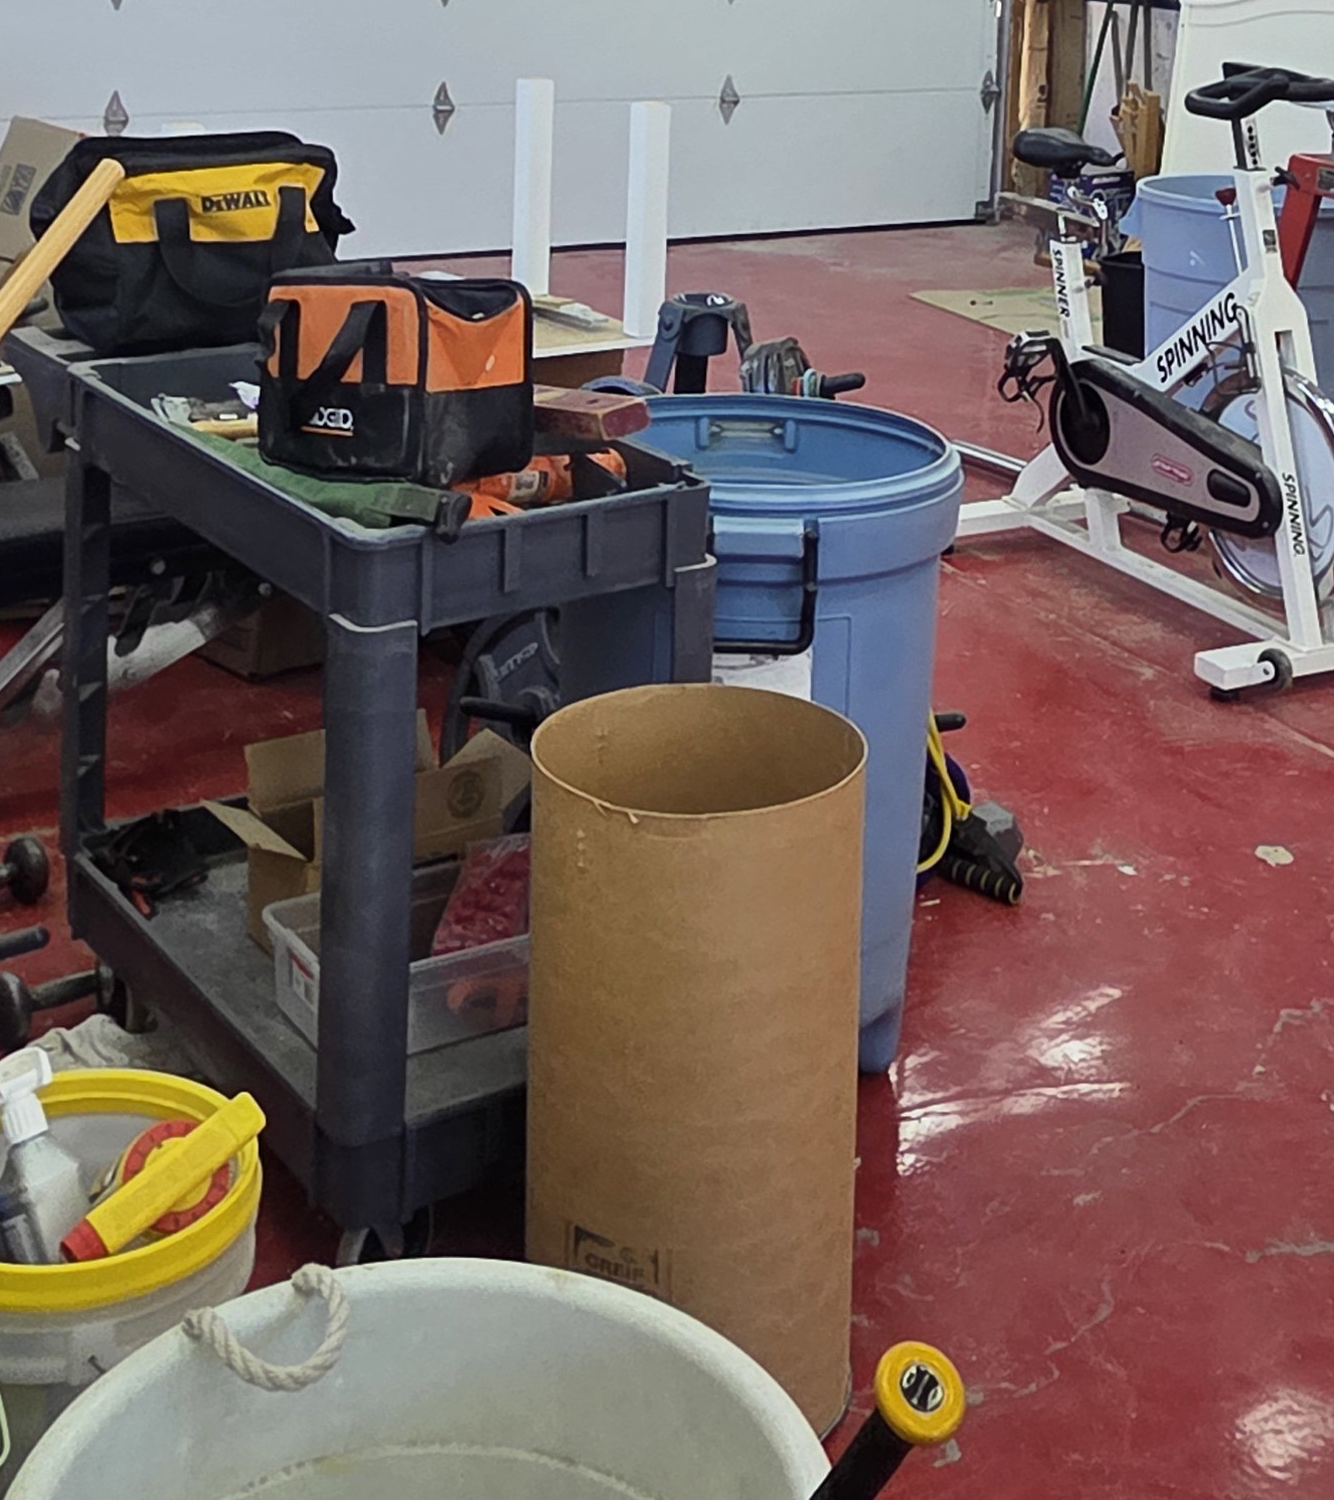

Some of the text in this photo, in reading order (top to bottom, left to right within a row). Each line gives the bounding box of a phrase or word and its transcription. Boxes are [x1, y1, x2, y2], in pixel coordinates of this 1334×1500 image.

[1052, 249, 1071, 319] SPINNER
[1156, 292, 1238, 384] SPINNING
[1282, 473, 1306, 556] SPINNING
